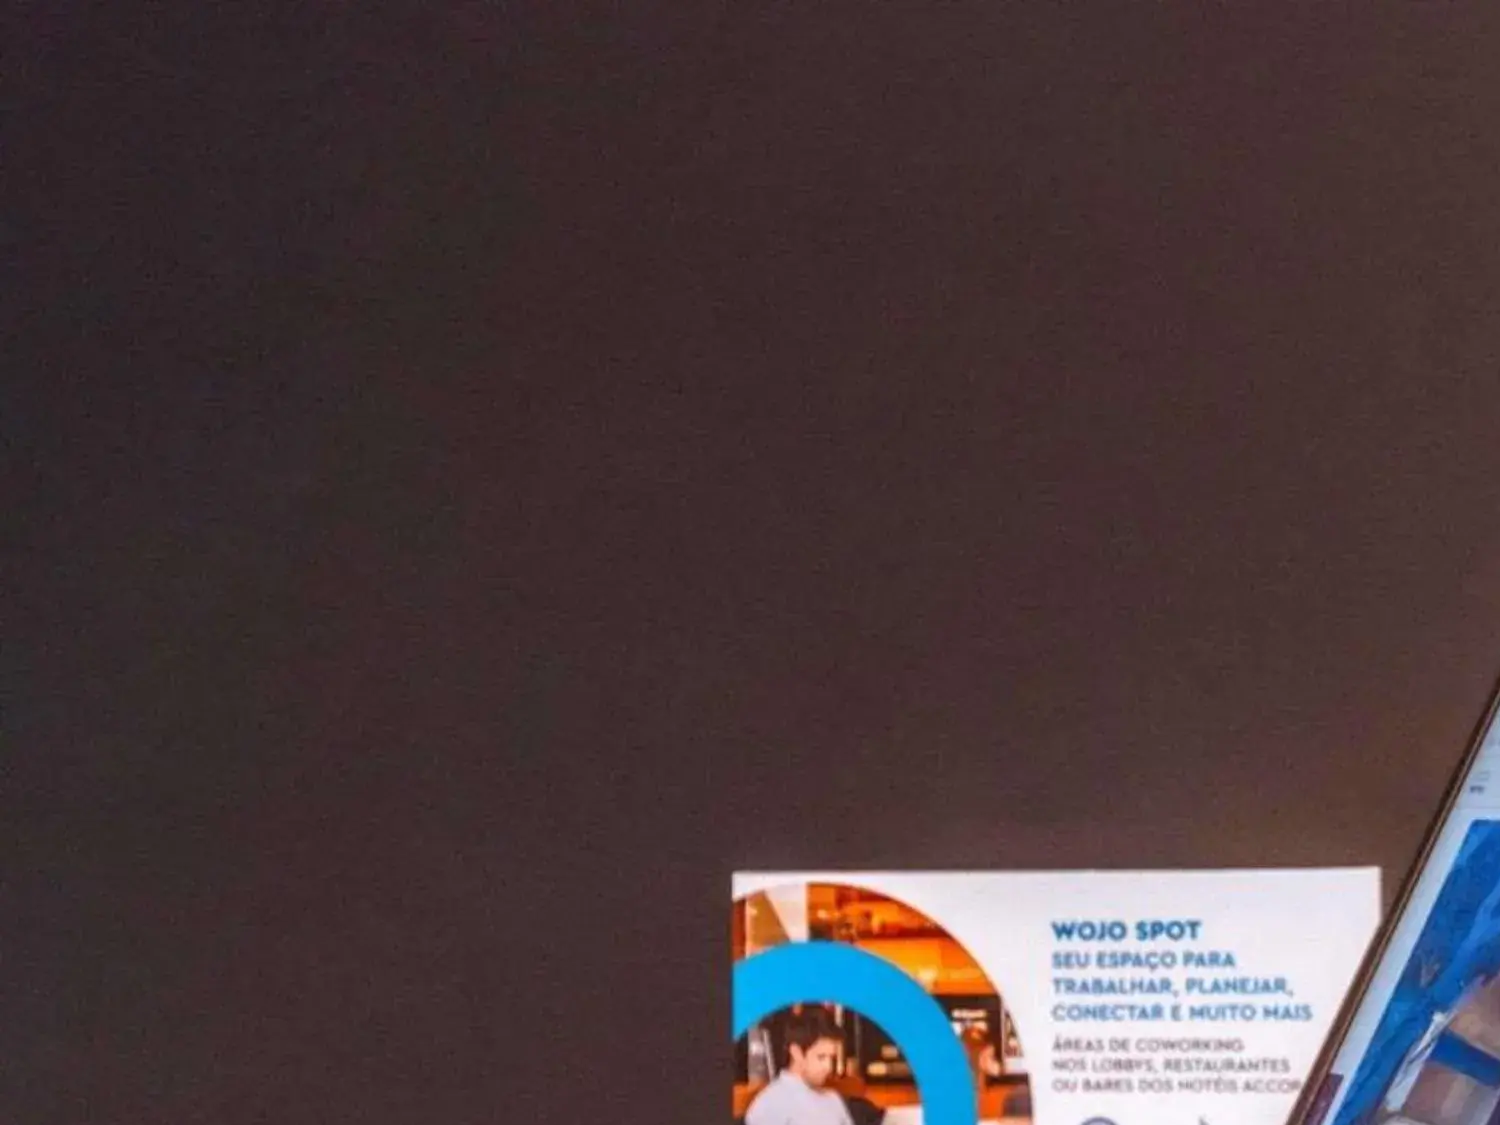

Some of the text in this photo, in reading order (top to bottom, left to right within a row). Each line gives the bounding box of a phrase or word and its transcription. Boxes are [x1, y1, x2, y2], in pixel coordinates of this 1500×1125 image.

[1051, 921, 1202, 941] WOJO SPOT
[1052, 951, 1235, 971] SEU ESPAÇO PARA
[1052, 978, 1294, 998] TRABALHAR, PLANEJAR,
[1051, 1004, 1313, 1021] CONECTAR E MUITO MAIS
[1052, 1036, 1245, 1052] ÁREAS DE COWORKING
[1053, 1059, 1086, 1073] NOS
[1163, 1058, 1290, 1073] RESTAURANTES
[1052, 1079, 1077, 1093] OU
[1082, 1079, 1133, 1093] BARES
[1138, 1079, 1173, 1093] DOS
